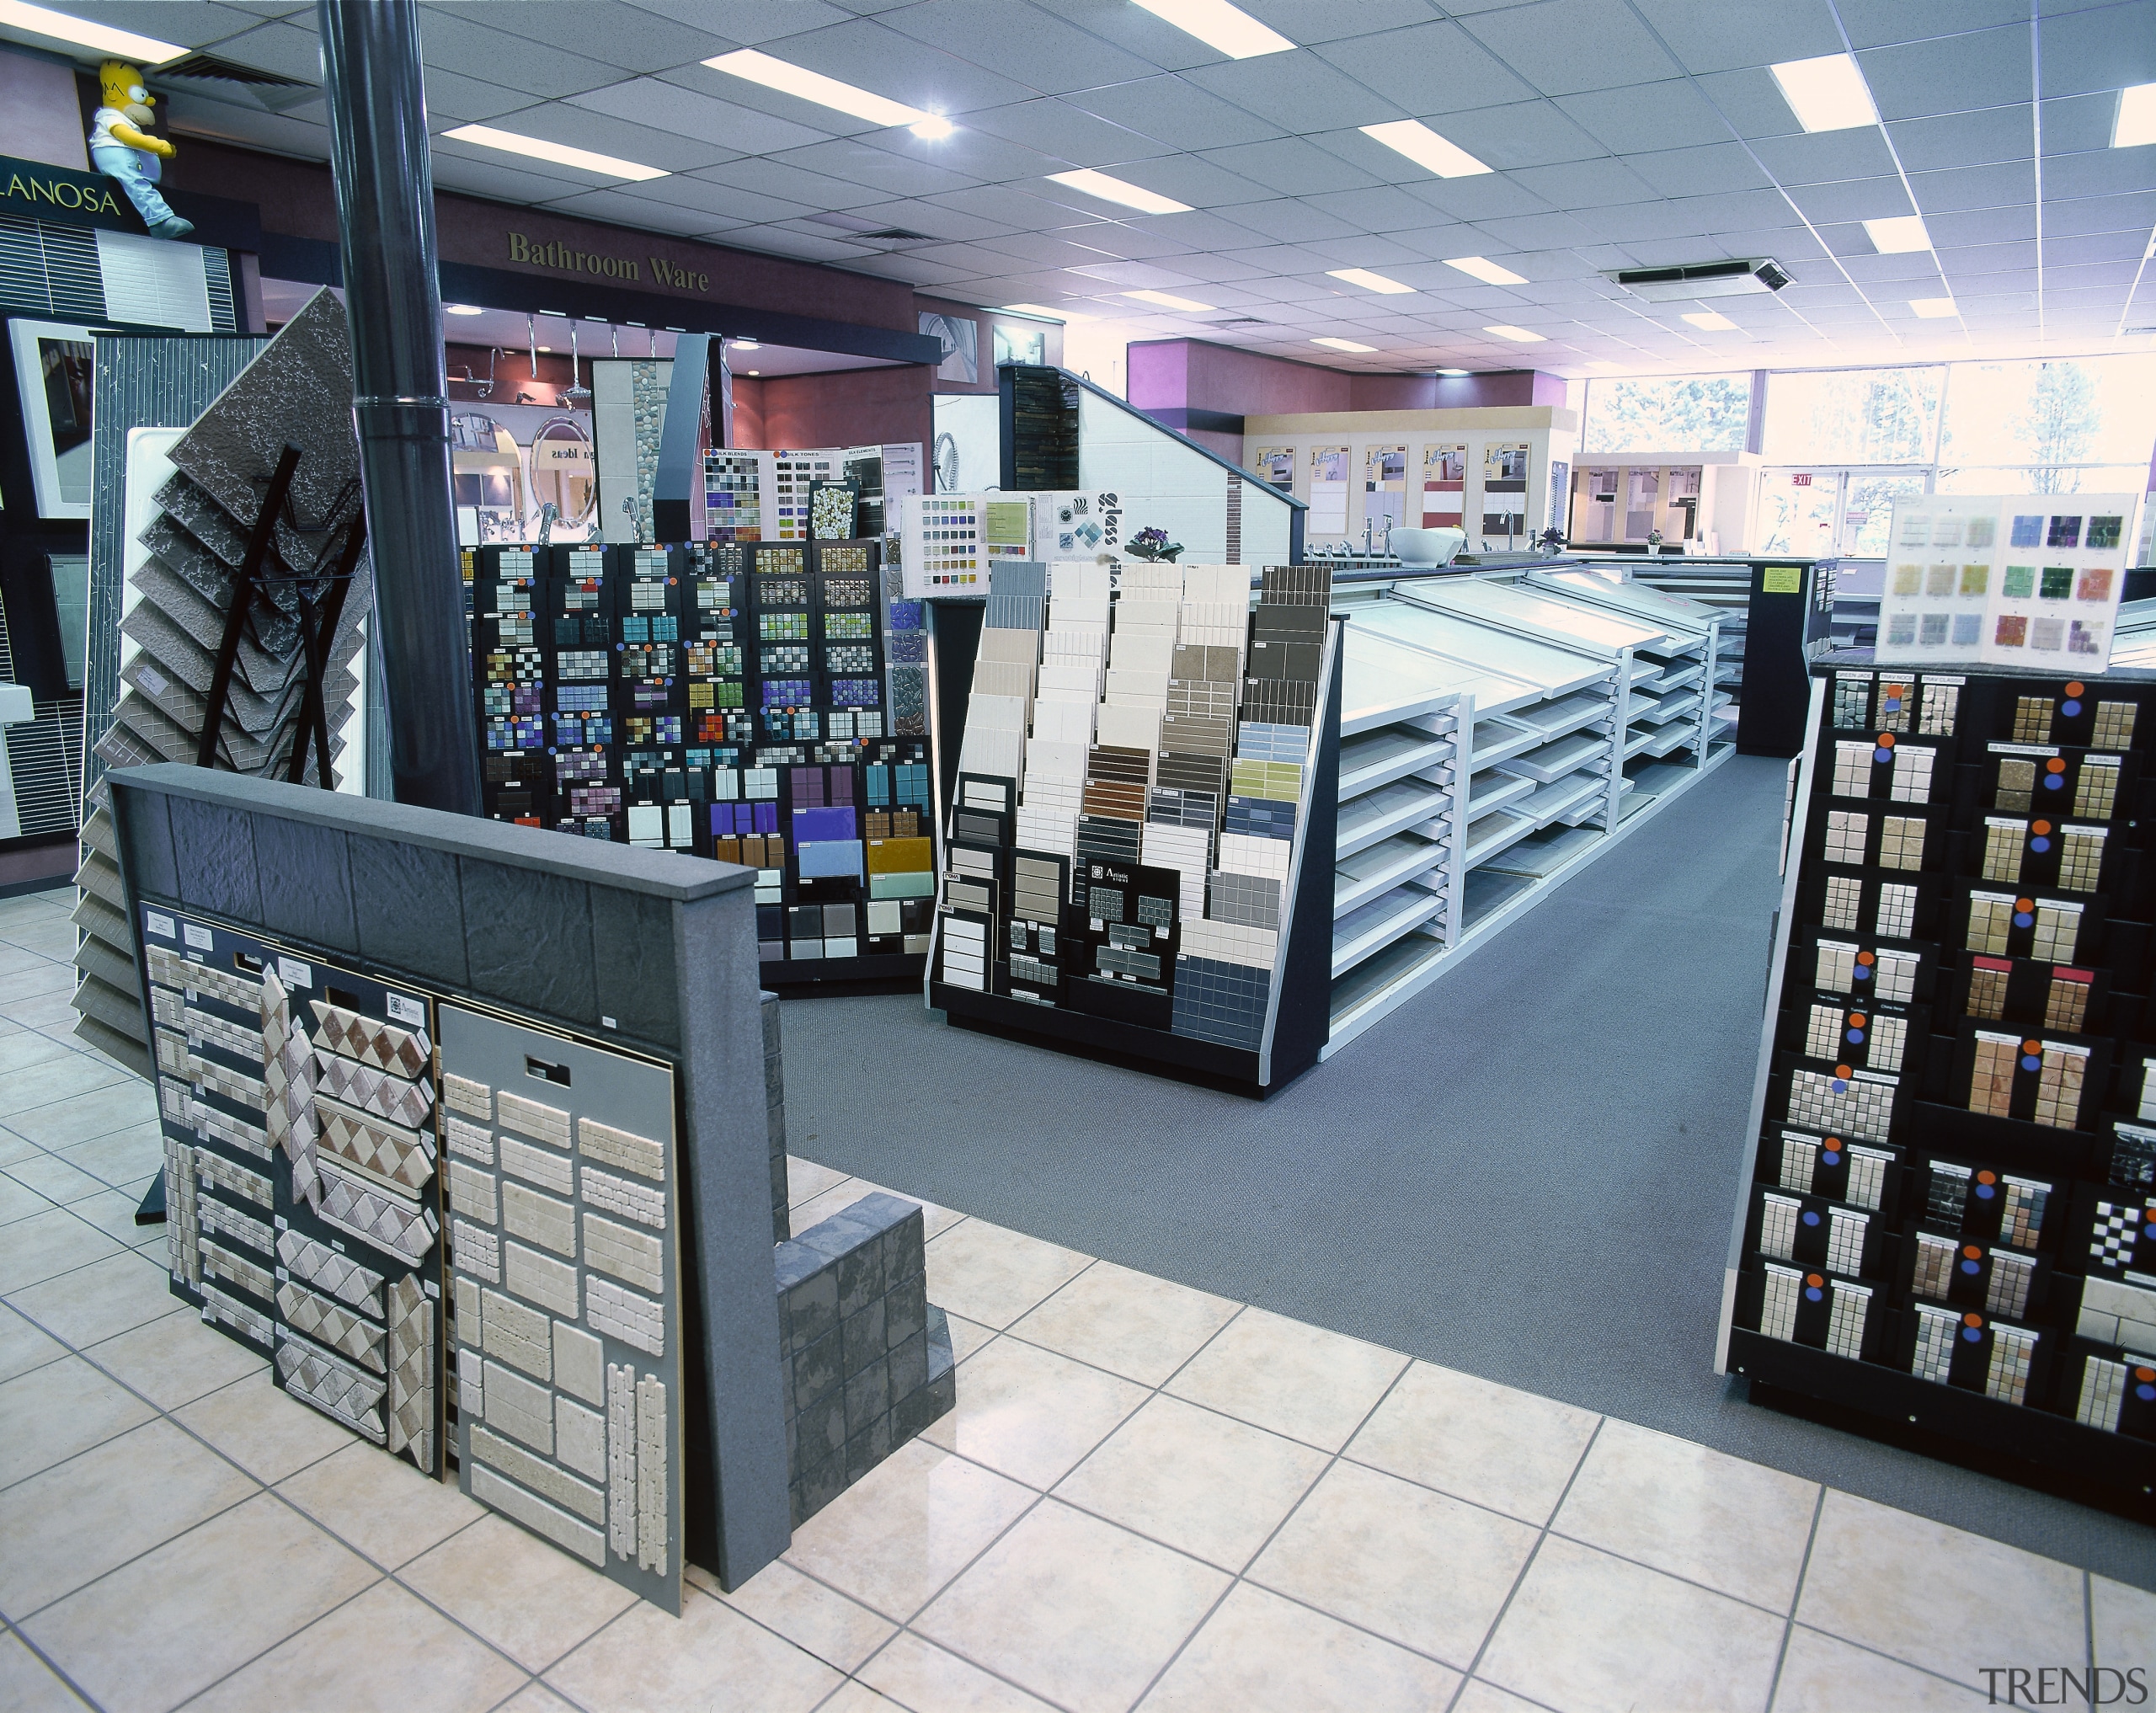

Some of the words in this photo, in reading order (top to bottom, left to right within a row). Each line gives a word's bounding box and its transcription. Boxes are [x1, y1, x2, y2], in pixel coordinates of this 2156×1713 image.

[0, 173, 121, 216] ANOSA
[507, 232, 640, 281] Bathroom
[648, 257, 710, 292] Ware
[1792, 474, 1812, 485] EXIT
[1999, 745, 2038, 754] TRAVERTINE
[1107, 868, 1129, 879] Artistic
[1879, 1075, 1898, 1083] SHEET
[1857, 1147, 1873, 1155] CHINA
[1875, 1150, 1893, 1159] BEIGE
